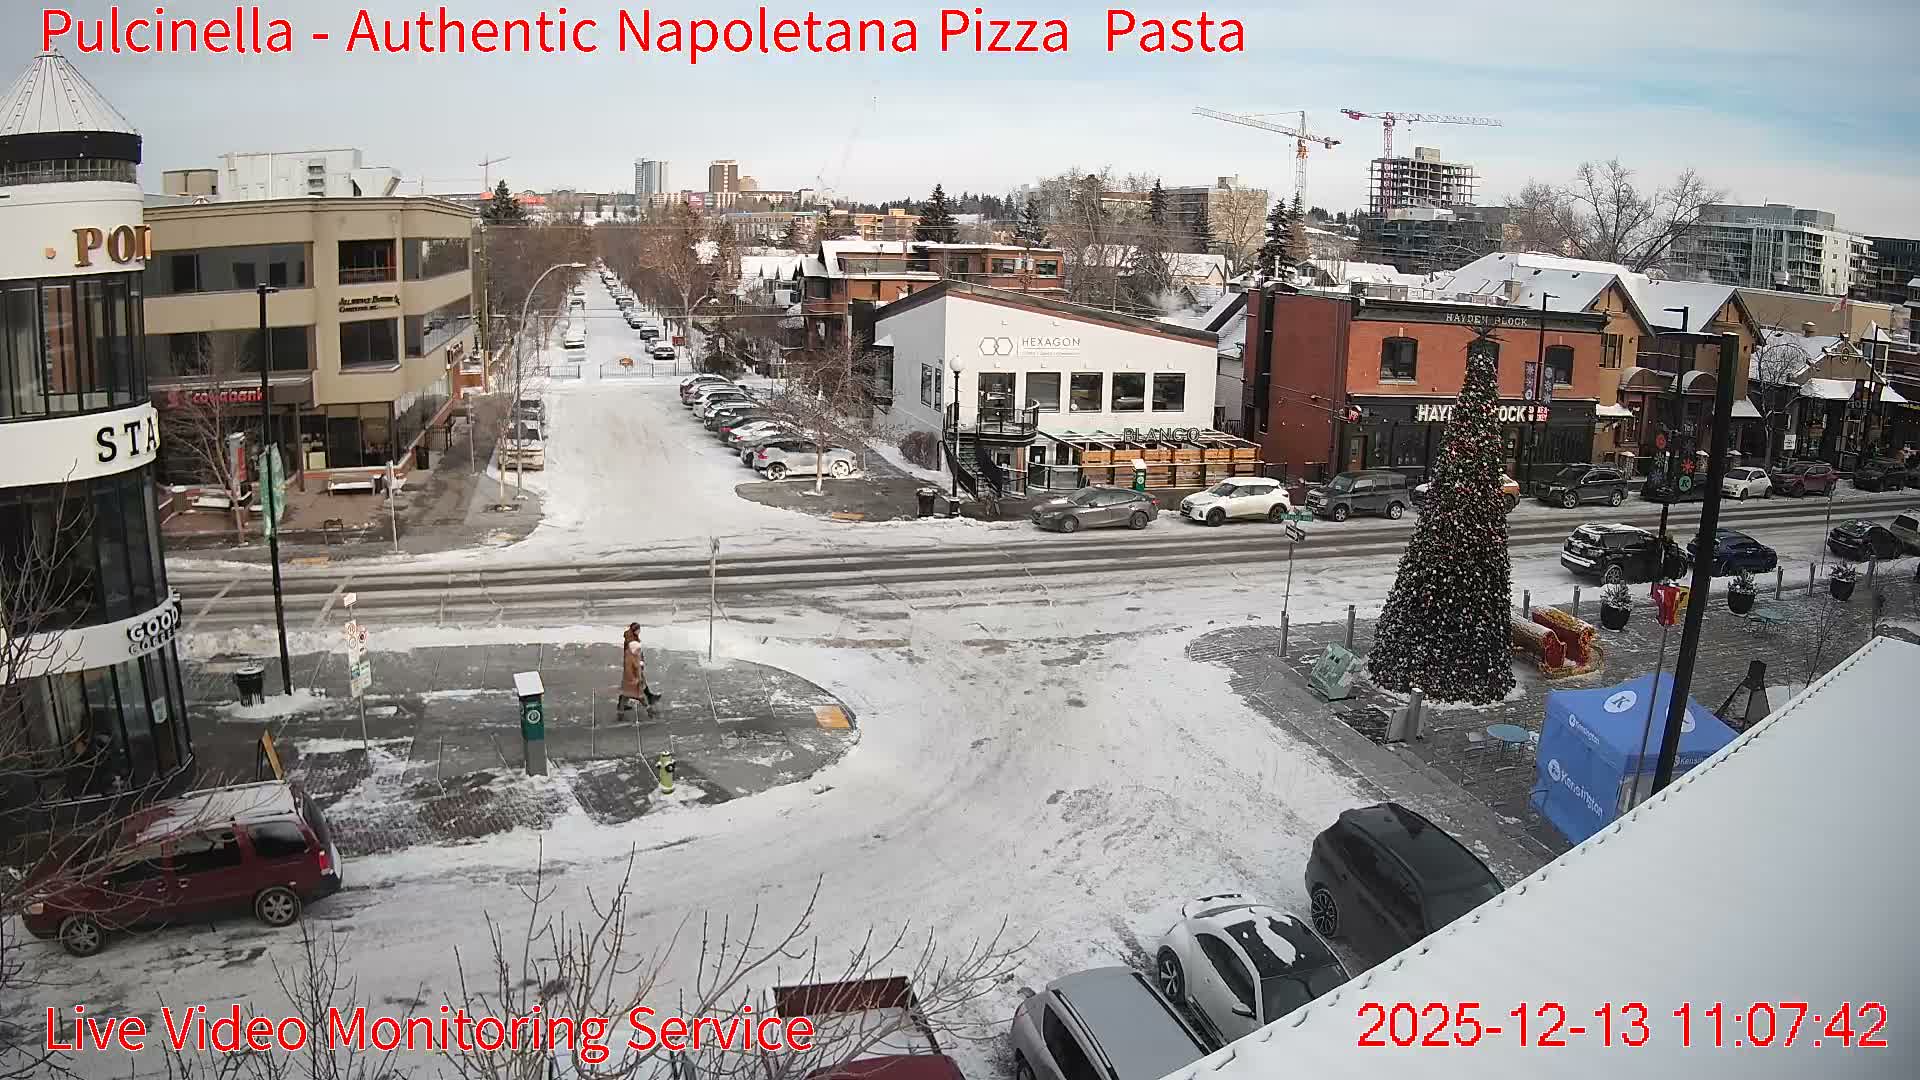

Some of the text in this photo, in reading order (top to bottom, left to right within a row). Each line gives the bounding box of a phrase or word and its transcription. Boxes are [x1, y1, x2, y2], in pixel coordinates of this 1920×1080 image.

[1446, 313, 1528, 327] HAYDEN BLOCK
[1023, 337, 1081, 347] HEXAGON
[130, 606, 179, 642] GOOD
[1560, 770, 1603, 817] Kensington
